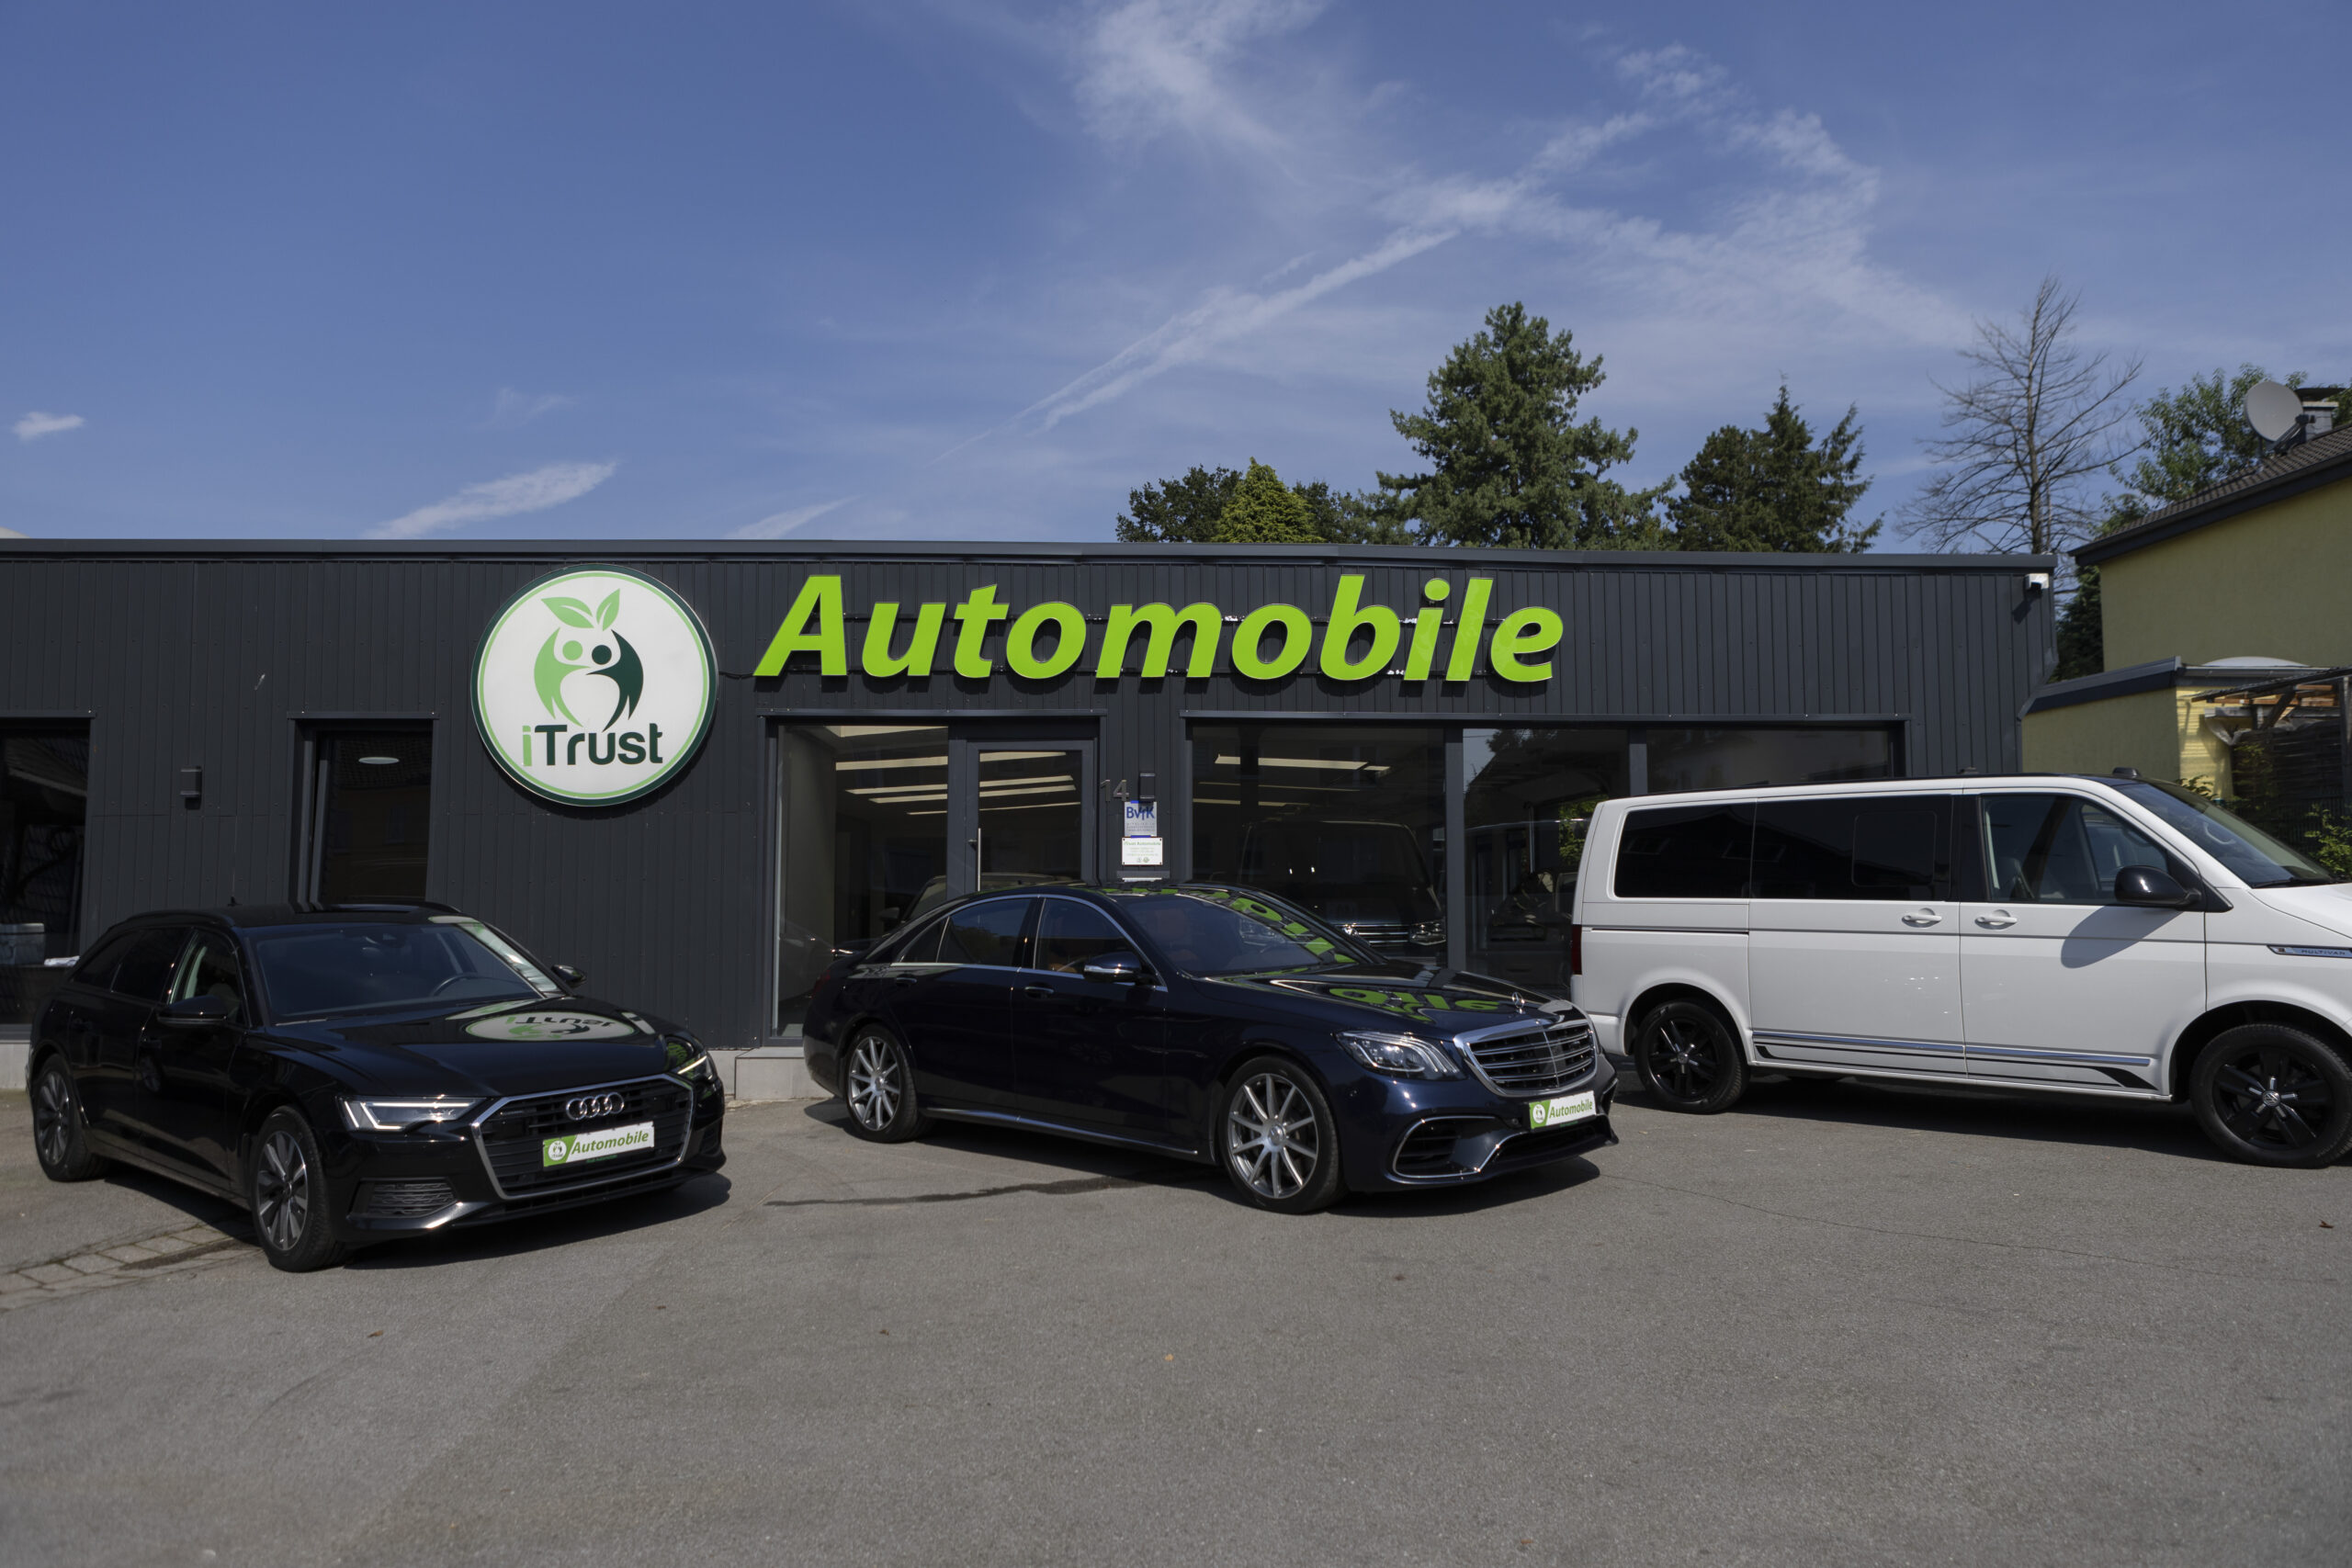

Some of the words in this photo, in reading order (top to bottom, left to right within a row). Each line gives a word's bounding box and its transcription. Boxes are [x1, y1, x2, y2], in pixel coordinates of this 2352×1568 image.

[752, 574, 1564, 682] Automobile
[522, 723, 663, 767] iTrust
[1099, 779, 1130, 802] 14
[1549, 1100, 1593, 1118] Automobile
[571, 1131, 649, 1155] Automobile
